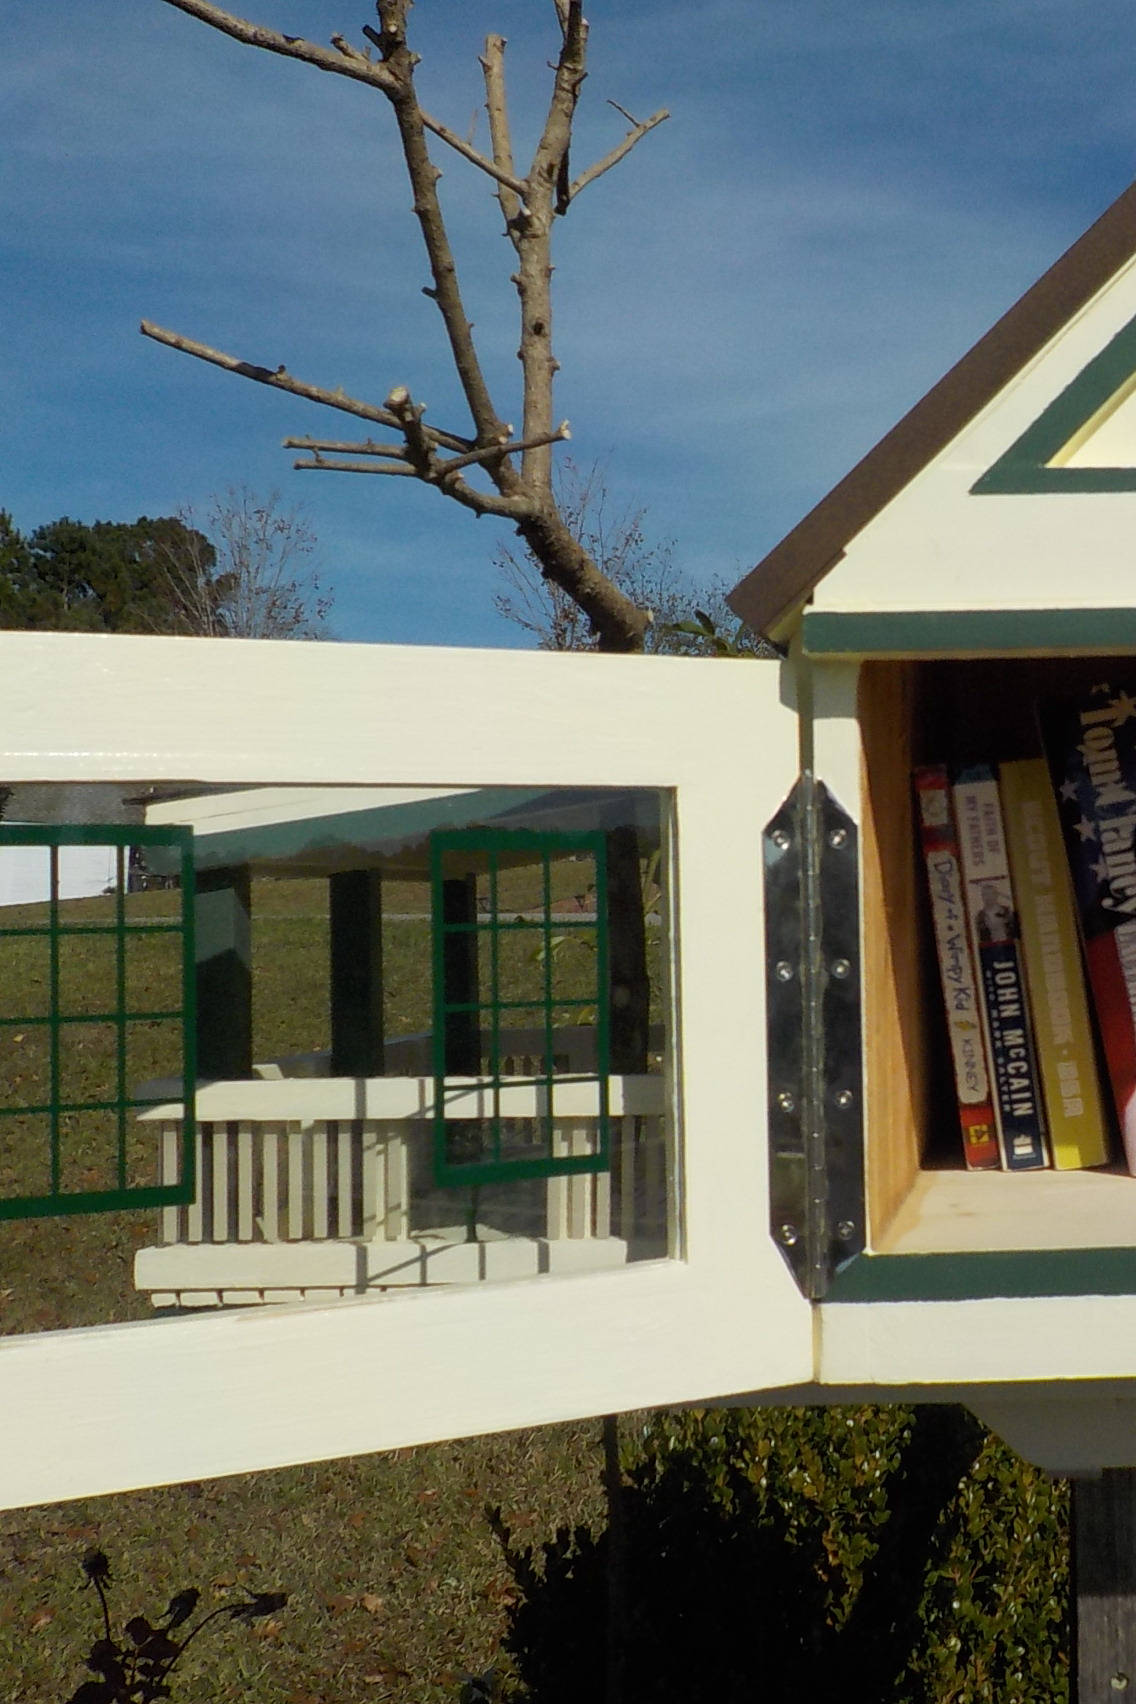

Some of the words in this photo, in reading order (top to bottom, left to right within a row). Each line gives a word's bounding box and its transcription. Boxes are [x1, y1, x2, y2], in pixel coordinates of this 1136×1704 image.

[1080, 699, 1130, 787] Tom
[952, 987, 972, 1010] Kid
[992, 961, 1021, 1017] JOHN
